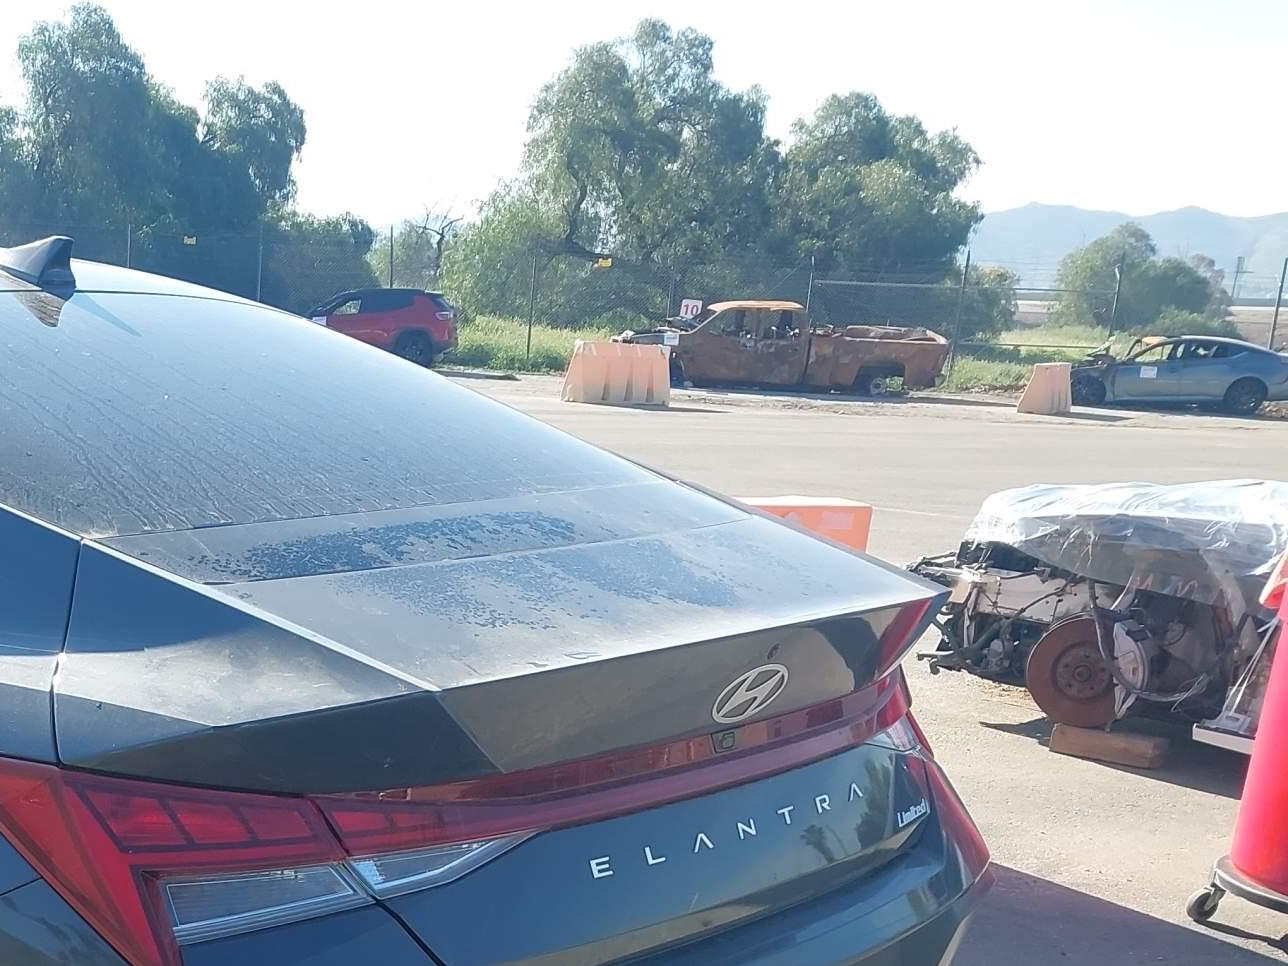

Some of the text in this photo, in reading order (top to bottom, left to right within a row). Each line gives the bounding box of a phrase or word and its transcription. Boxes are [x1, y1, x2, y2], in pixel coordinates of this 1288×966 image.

[683, 304, 699, 316] 10
[896, 797, 927, 828] Limited
[589, 782, 865, 879] ELANTRA
